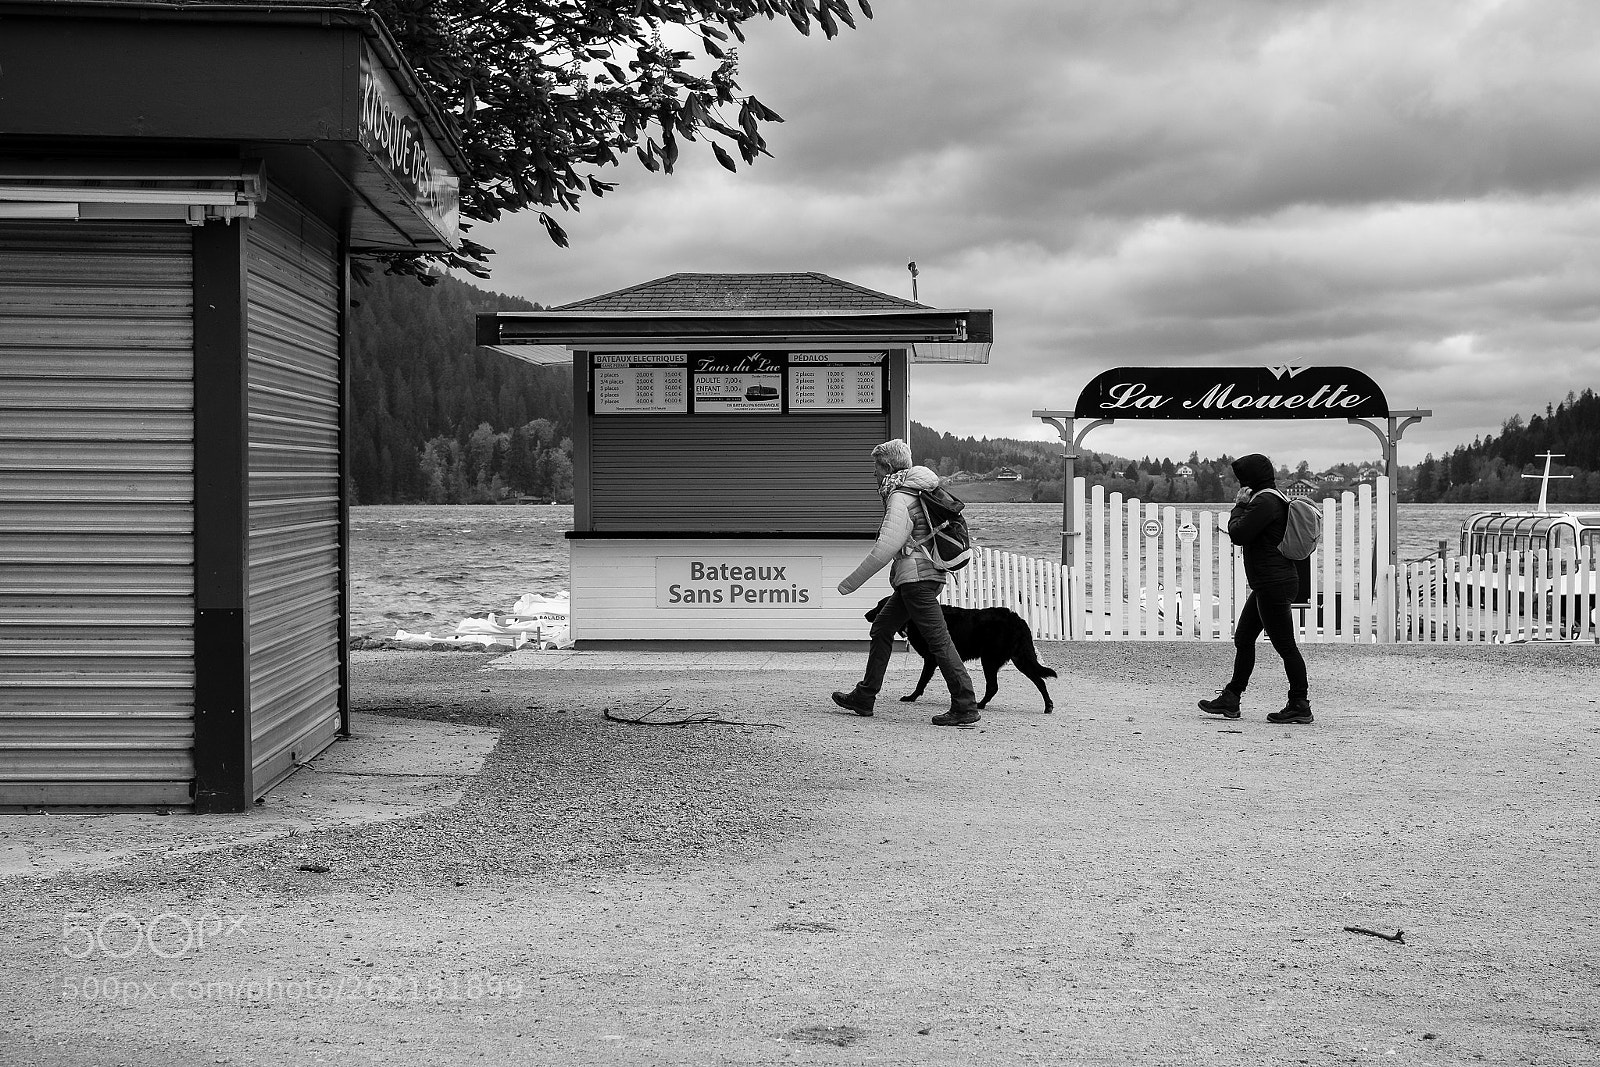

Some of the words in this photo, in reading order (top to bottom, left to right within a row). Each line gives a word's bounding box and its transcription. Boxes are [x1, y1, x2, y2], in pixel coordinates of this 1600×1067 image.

[363, 74, 412, 174] KIOSQUE
[412, 140, 430, 198] DES
[694, 356, 730, 371] Tour
[733, 359, 750, 371] du
[754, 358, 780, 371] Lac
[1100, 383, 1174, 408] La
[1183, 383, 1372, 409] Mouette
[691, 562, 786, 580] Bateaux
[669, 584, 723, 603] Sans
[730, 584, 810, 603] Permis
